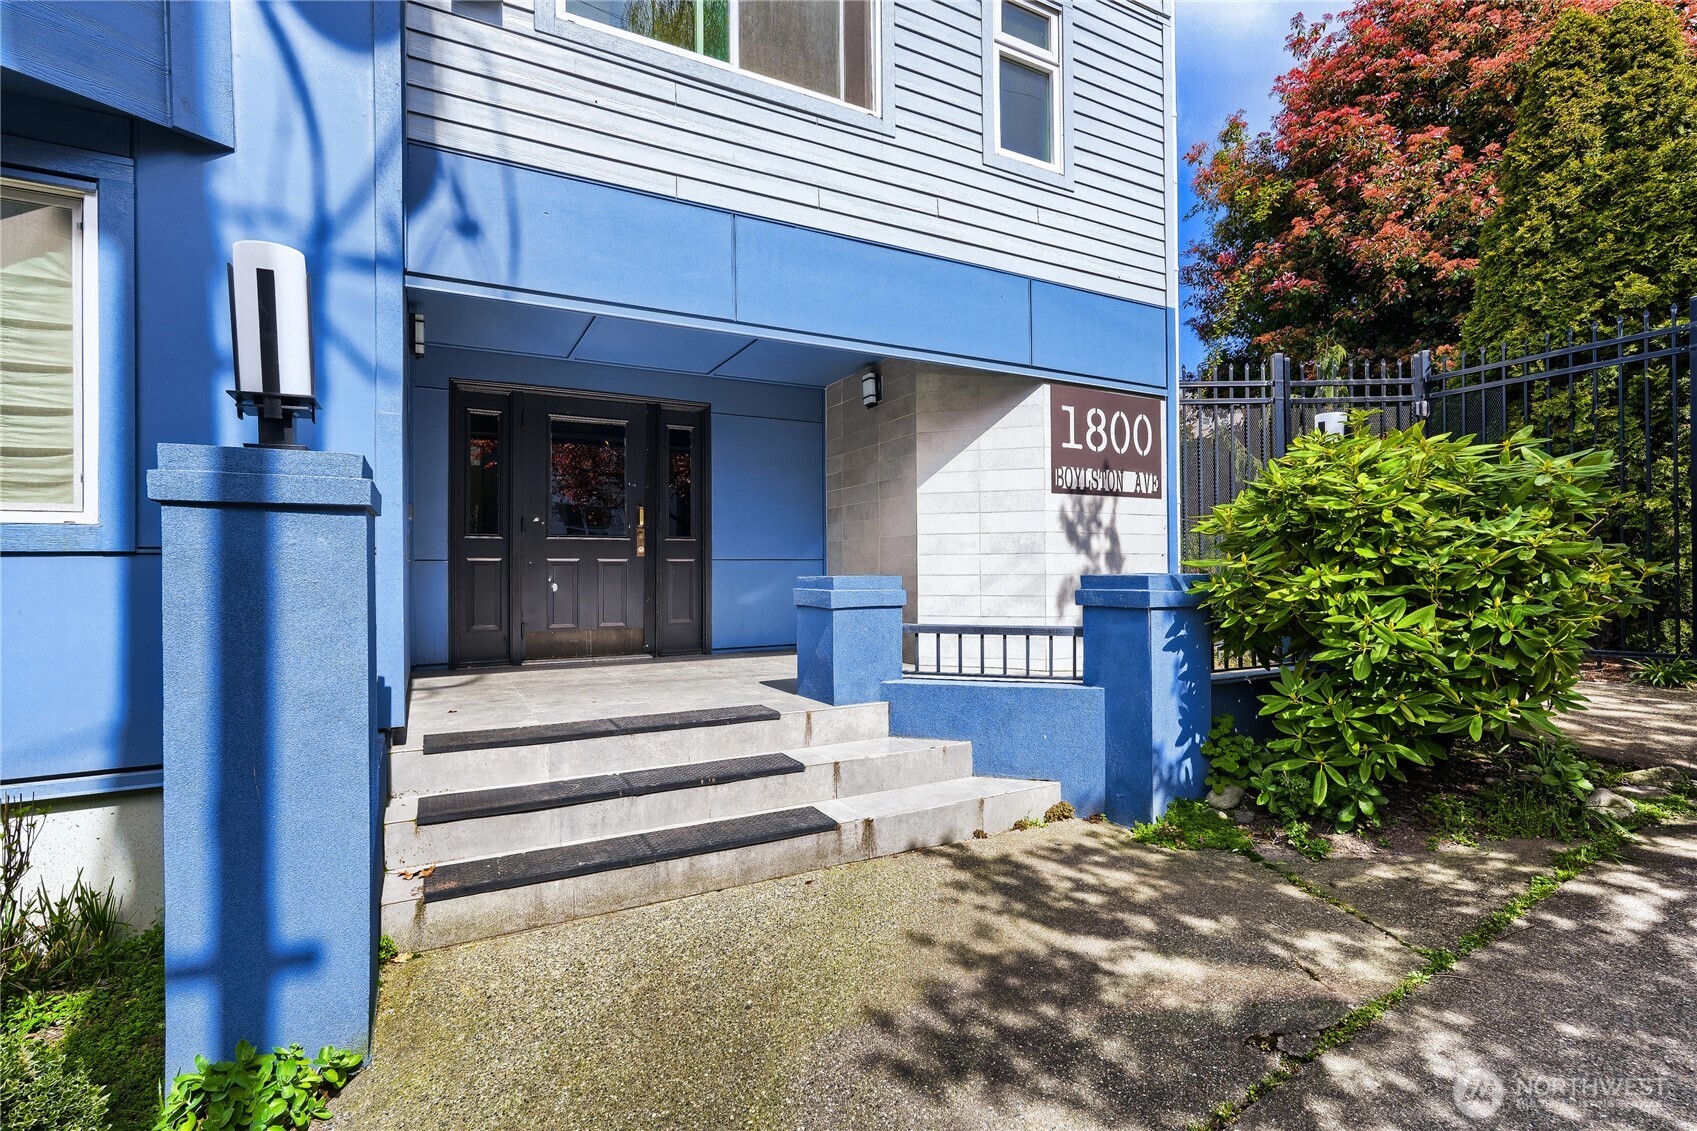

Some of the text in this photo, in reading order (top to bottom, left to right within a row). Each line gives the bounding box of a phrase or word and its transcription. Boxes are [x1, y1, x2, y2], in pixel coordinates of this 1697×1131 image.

[1061, 404, 1153, 457] 1800
[1055, 466, 1159, 493] BOYLSTON AVE
